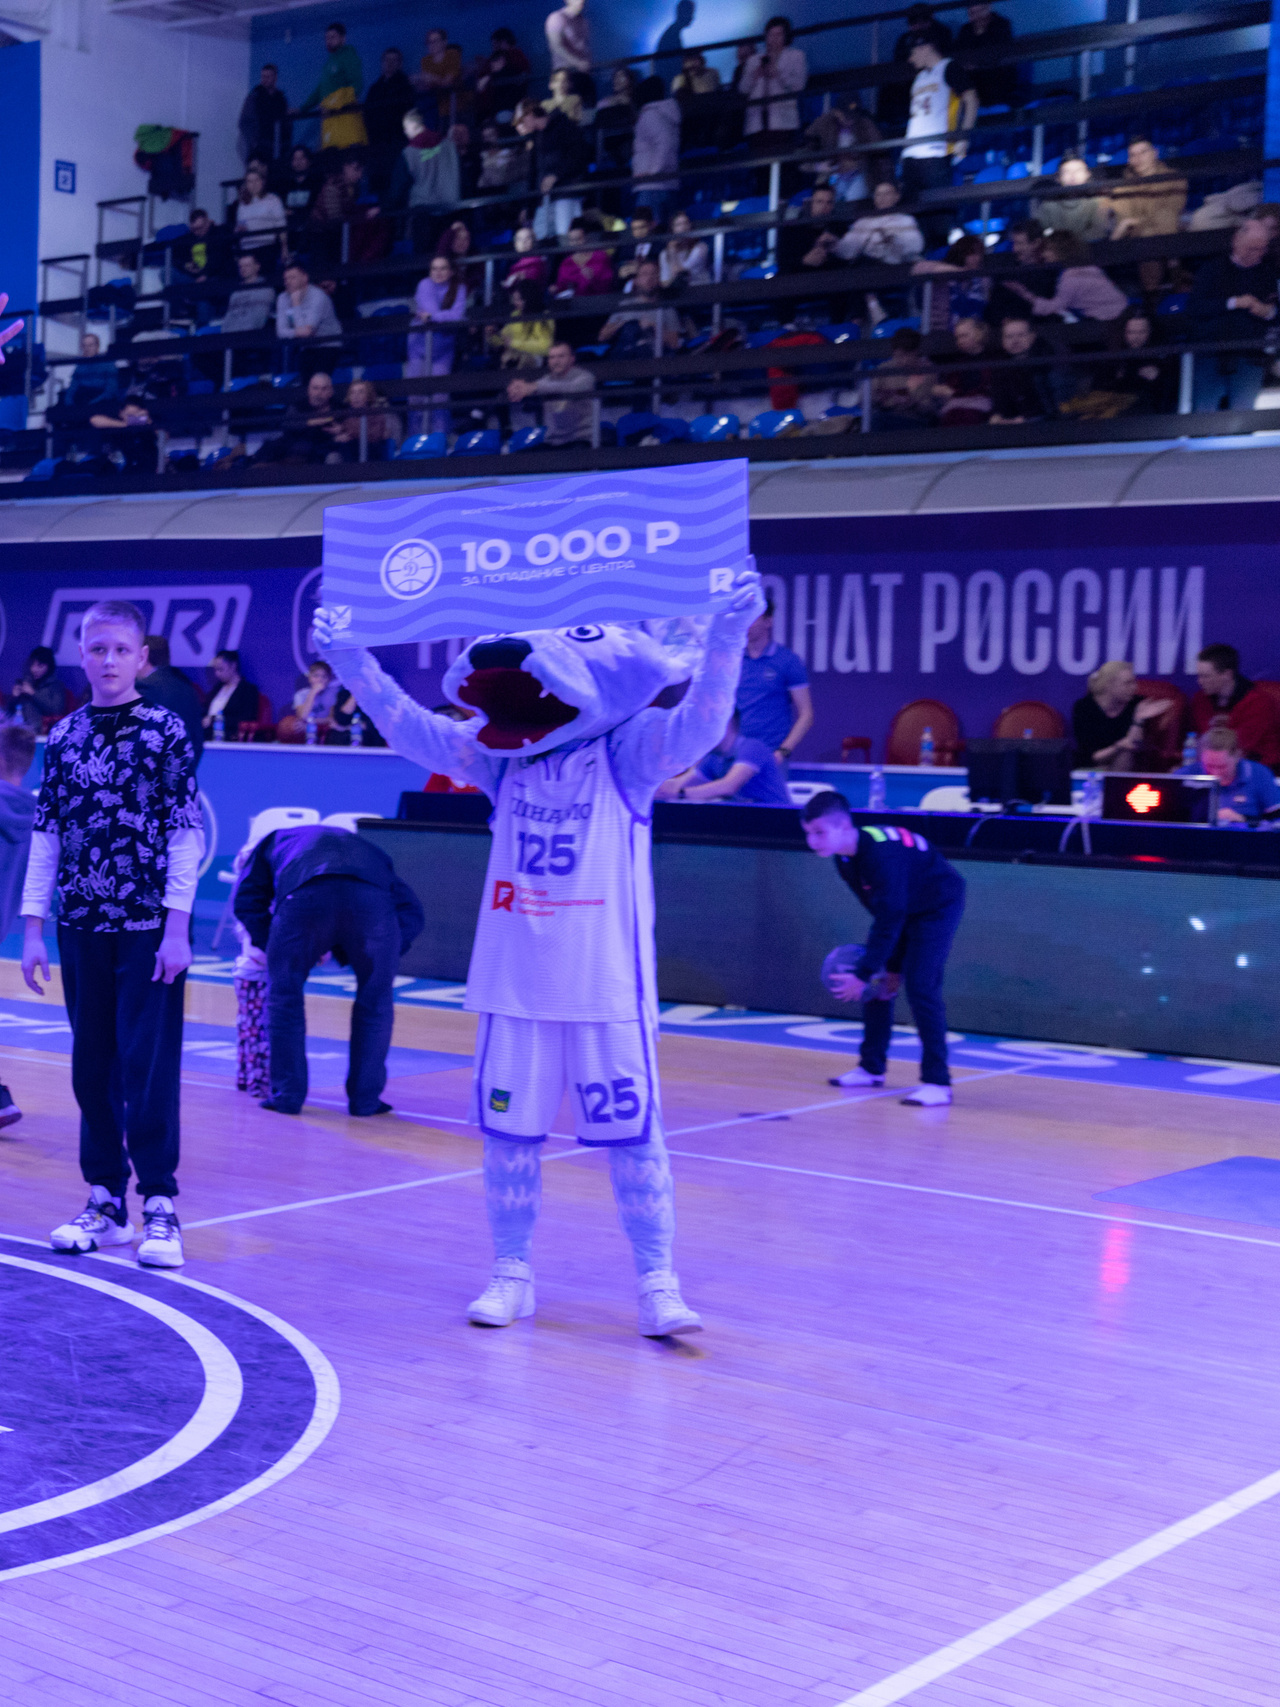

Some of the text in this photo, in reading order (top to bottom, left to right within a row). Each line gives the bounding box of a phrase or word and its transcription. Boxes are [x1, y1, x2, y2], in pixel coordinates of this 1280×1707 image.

[461, 538, 511, 573] 10
[525, 526, 631, 566] 000
[461, 560, 636, 587] ЗА ПОПАДАНИЕ С ЦЕНТРА
[920, 566, 1205, 676] РОССИИ
[517, 831, 576, 876] 125
[576, 1077, 640, 1124] 125
